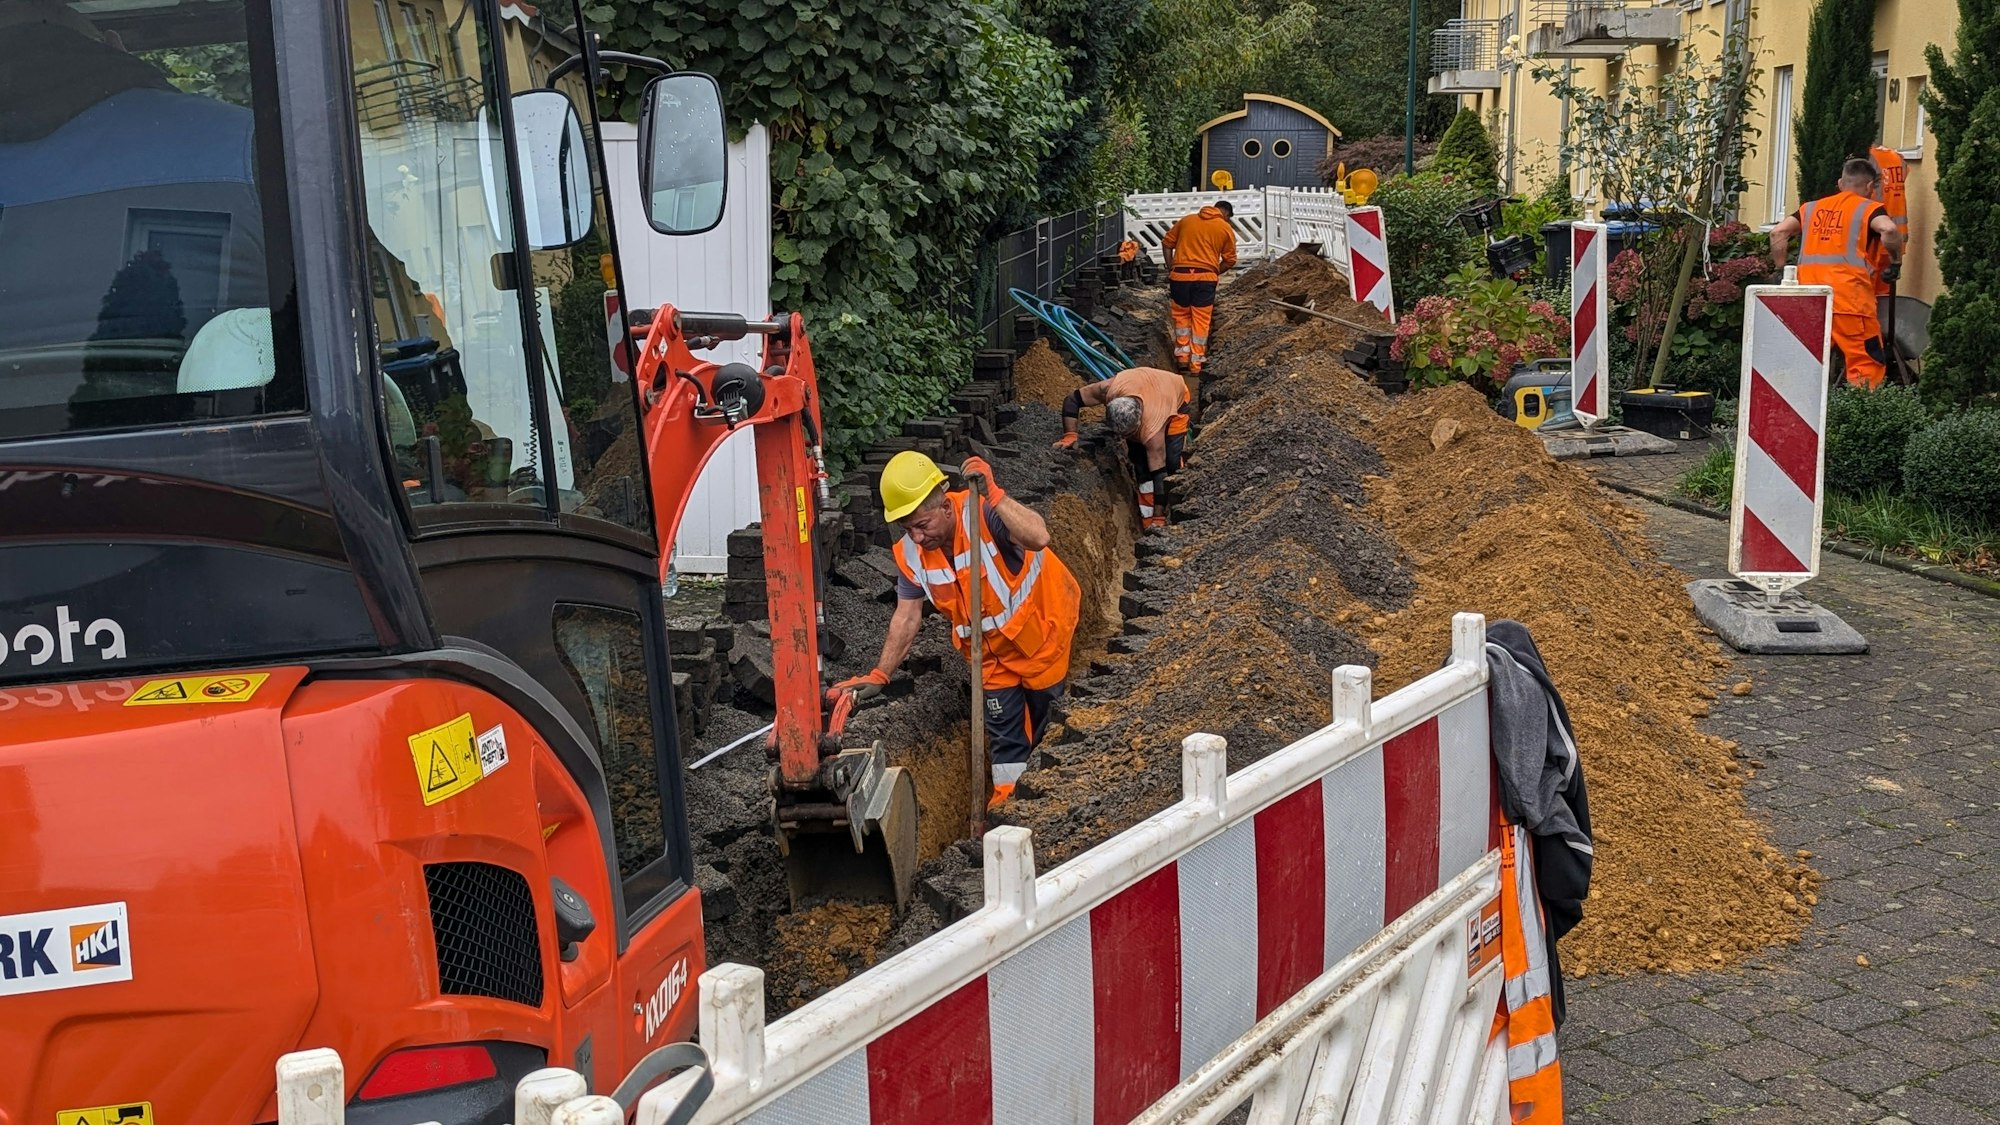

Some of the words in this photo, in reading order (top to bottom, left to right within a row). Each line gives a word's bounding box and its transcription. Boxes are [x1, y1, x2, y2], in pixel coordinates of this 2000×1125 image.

[1889, 78, 1900, 103] 60
[1813, 208, 1843, 229] STEL
[0, 605, 127, 666] ota
[75, 921, 118, 964] HKL
